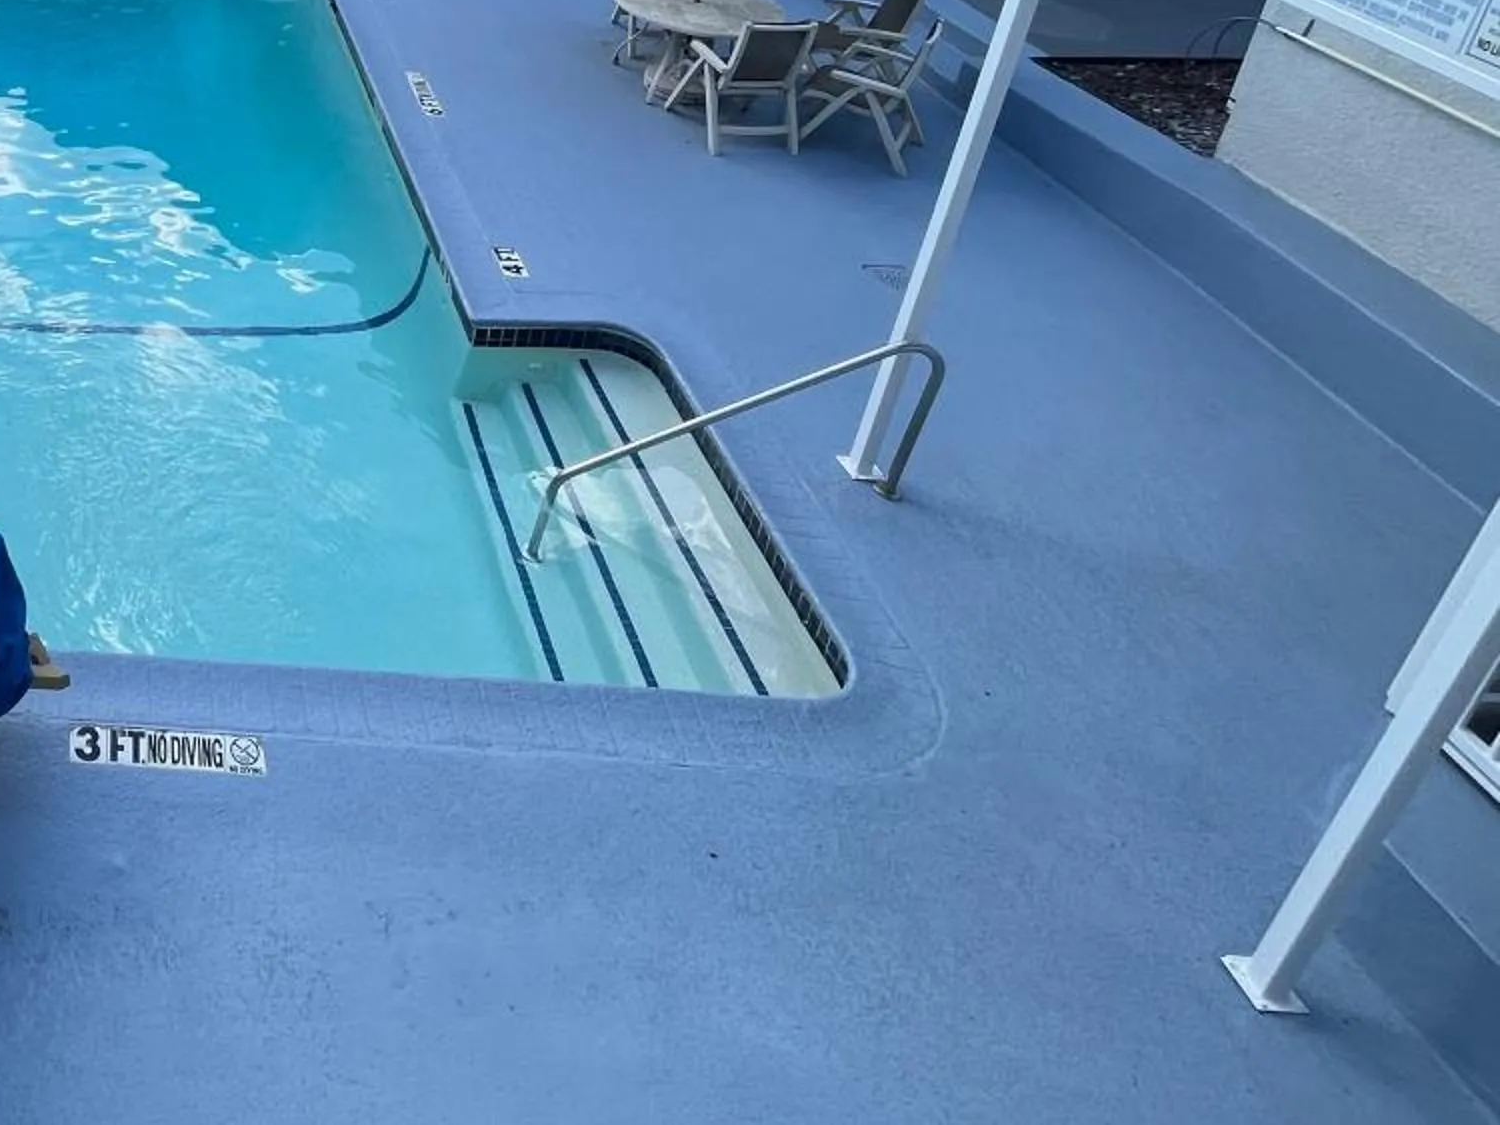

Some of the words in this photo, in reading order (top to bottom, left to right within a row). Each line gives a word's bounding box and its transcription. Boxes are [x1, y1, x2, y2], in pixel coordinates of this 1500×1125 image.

[502, 264, 524, 275] 4
[74, 726, 101, 762] 3
[148, 732, 167, 764] NO
[171, 736, 224, 768] DIVING
